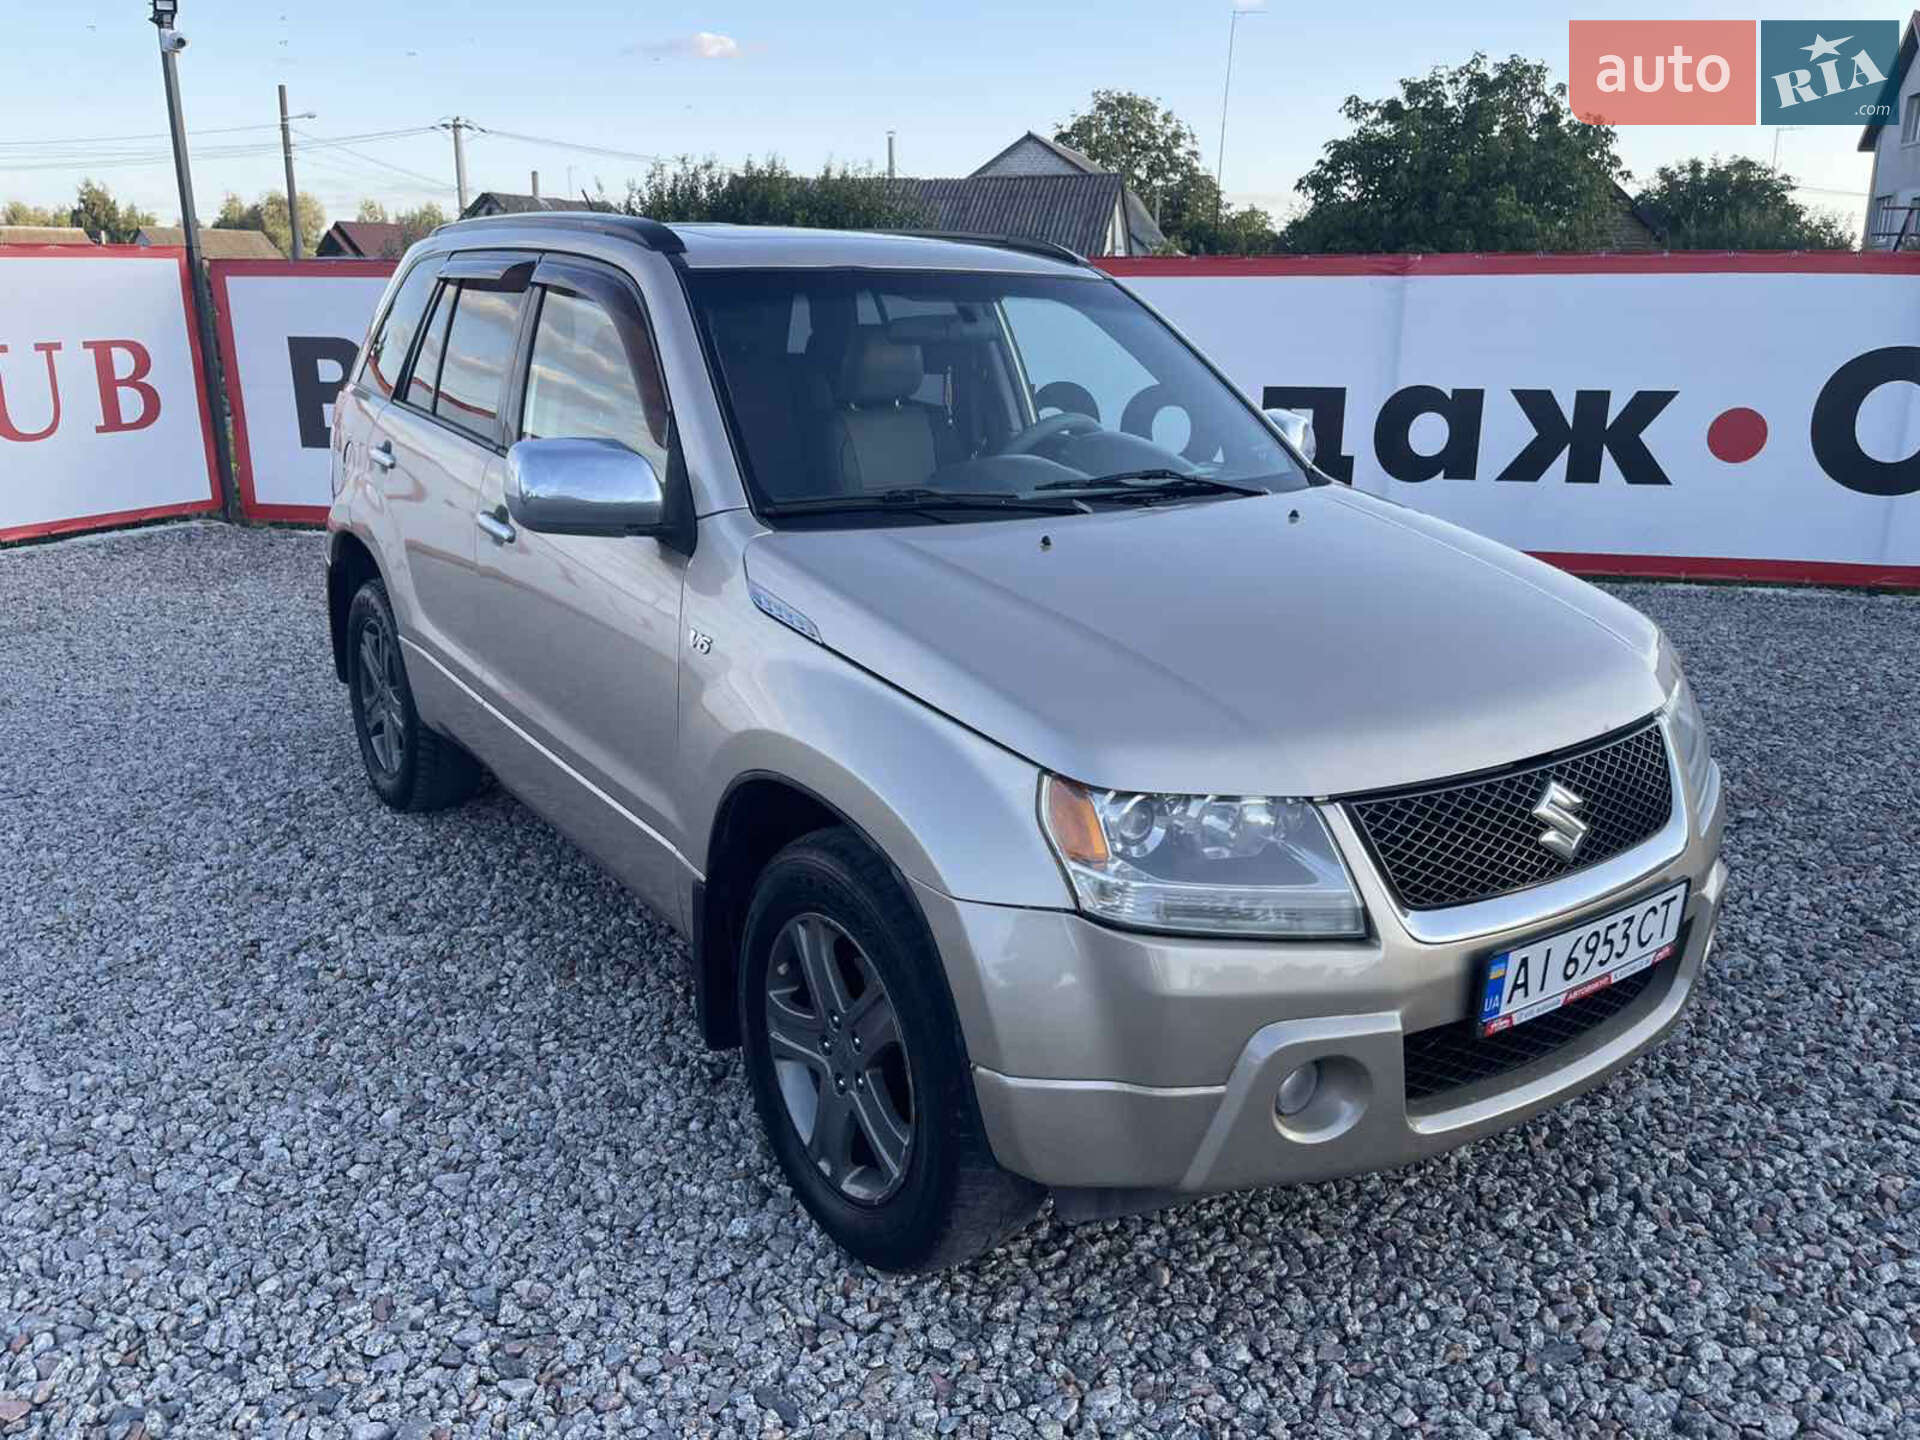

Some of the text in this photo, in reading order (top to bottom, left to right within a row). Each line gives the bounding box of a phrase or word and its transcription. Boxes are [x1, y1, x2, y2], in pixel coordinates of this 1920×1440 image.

[689, 627, 714, 655] V6
[1506, 948, 1551, 1004] AI
[1484, 997, 1500, 1013] UA
